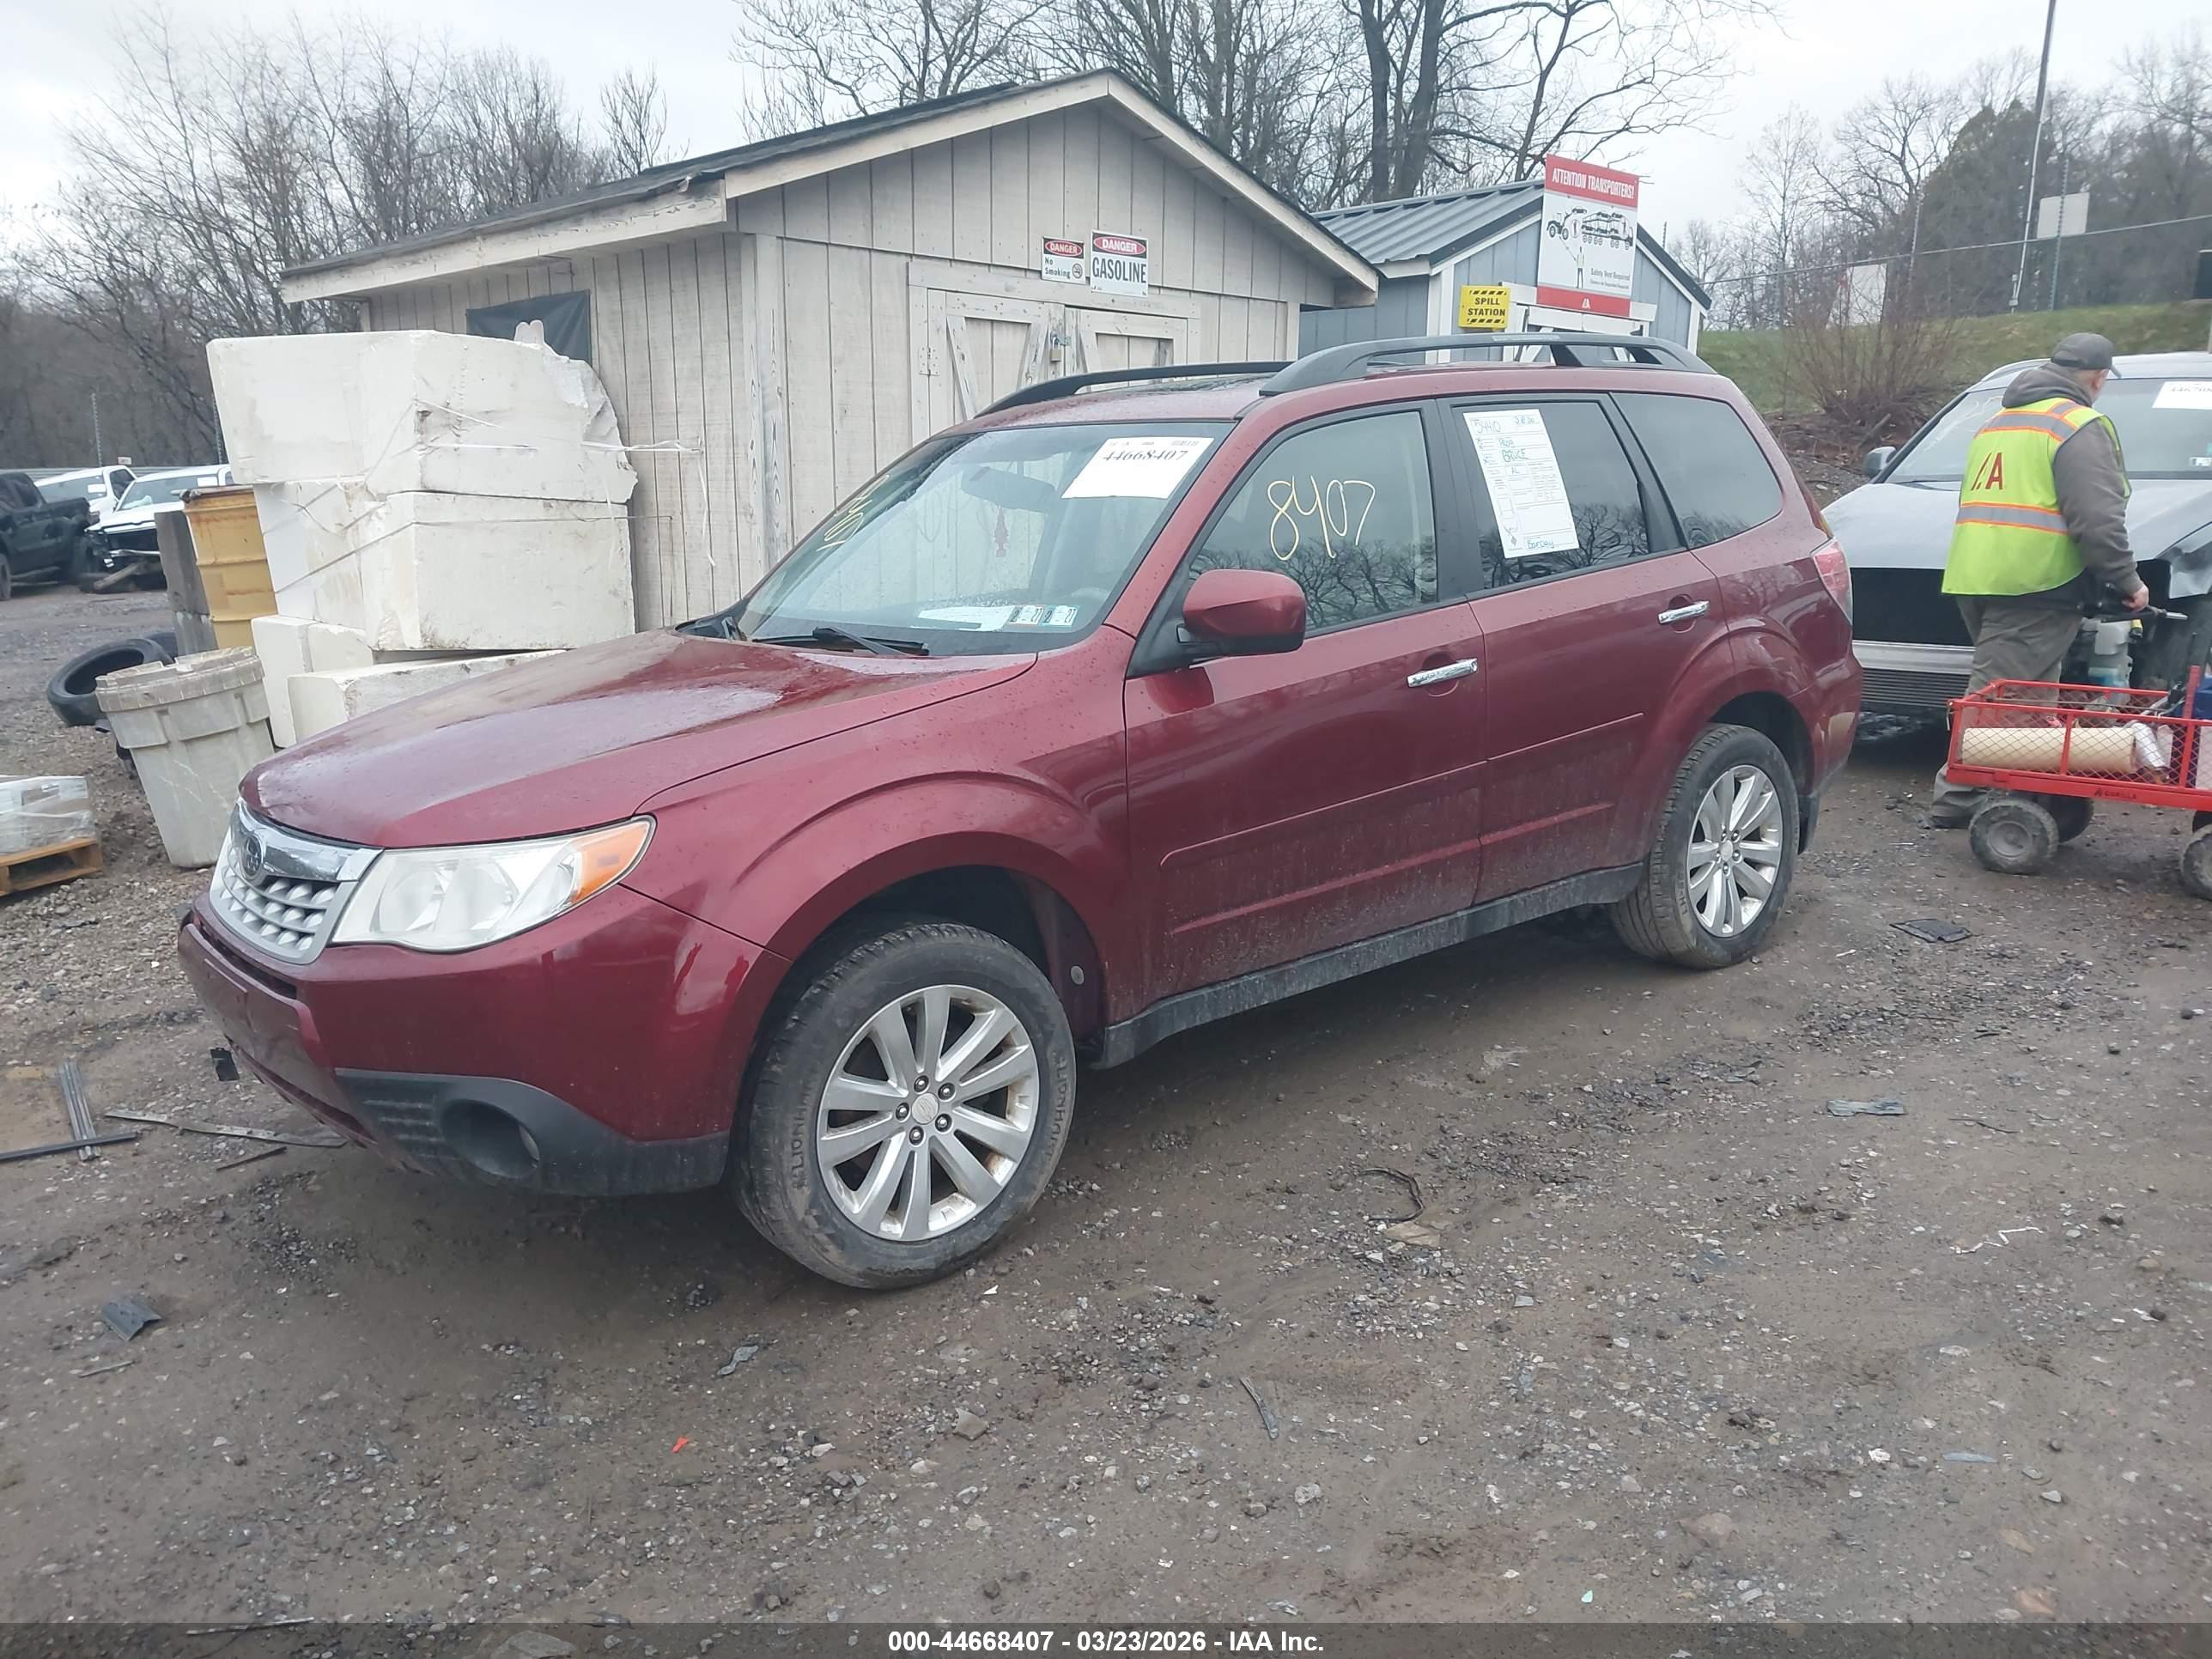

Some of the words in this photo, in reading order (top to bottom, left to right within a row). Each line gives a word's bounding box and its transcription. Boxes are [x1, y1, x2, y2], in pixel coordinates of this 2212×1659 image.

[1552, 167, 1587, 189] ATTENTION
[1588, 175, 1635, 199] TRANSPORTERS!
[1049, 242, 1078, 254] DANGER
[1102, 239, 1138, 253] DANGER
[1044, 257, 1054, 265] No
[1044, 267, 1072, 279] Smoking
[1092, 257, 1147, 283] GASOLINE
[1474, 297, 1500, 306] SPILL
[1468, 307, 1506, 317] STATION
[1103, 449, 1189, 461] 44668407
[1267, 475, 1376, 561] 8407
